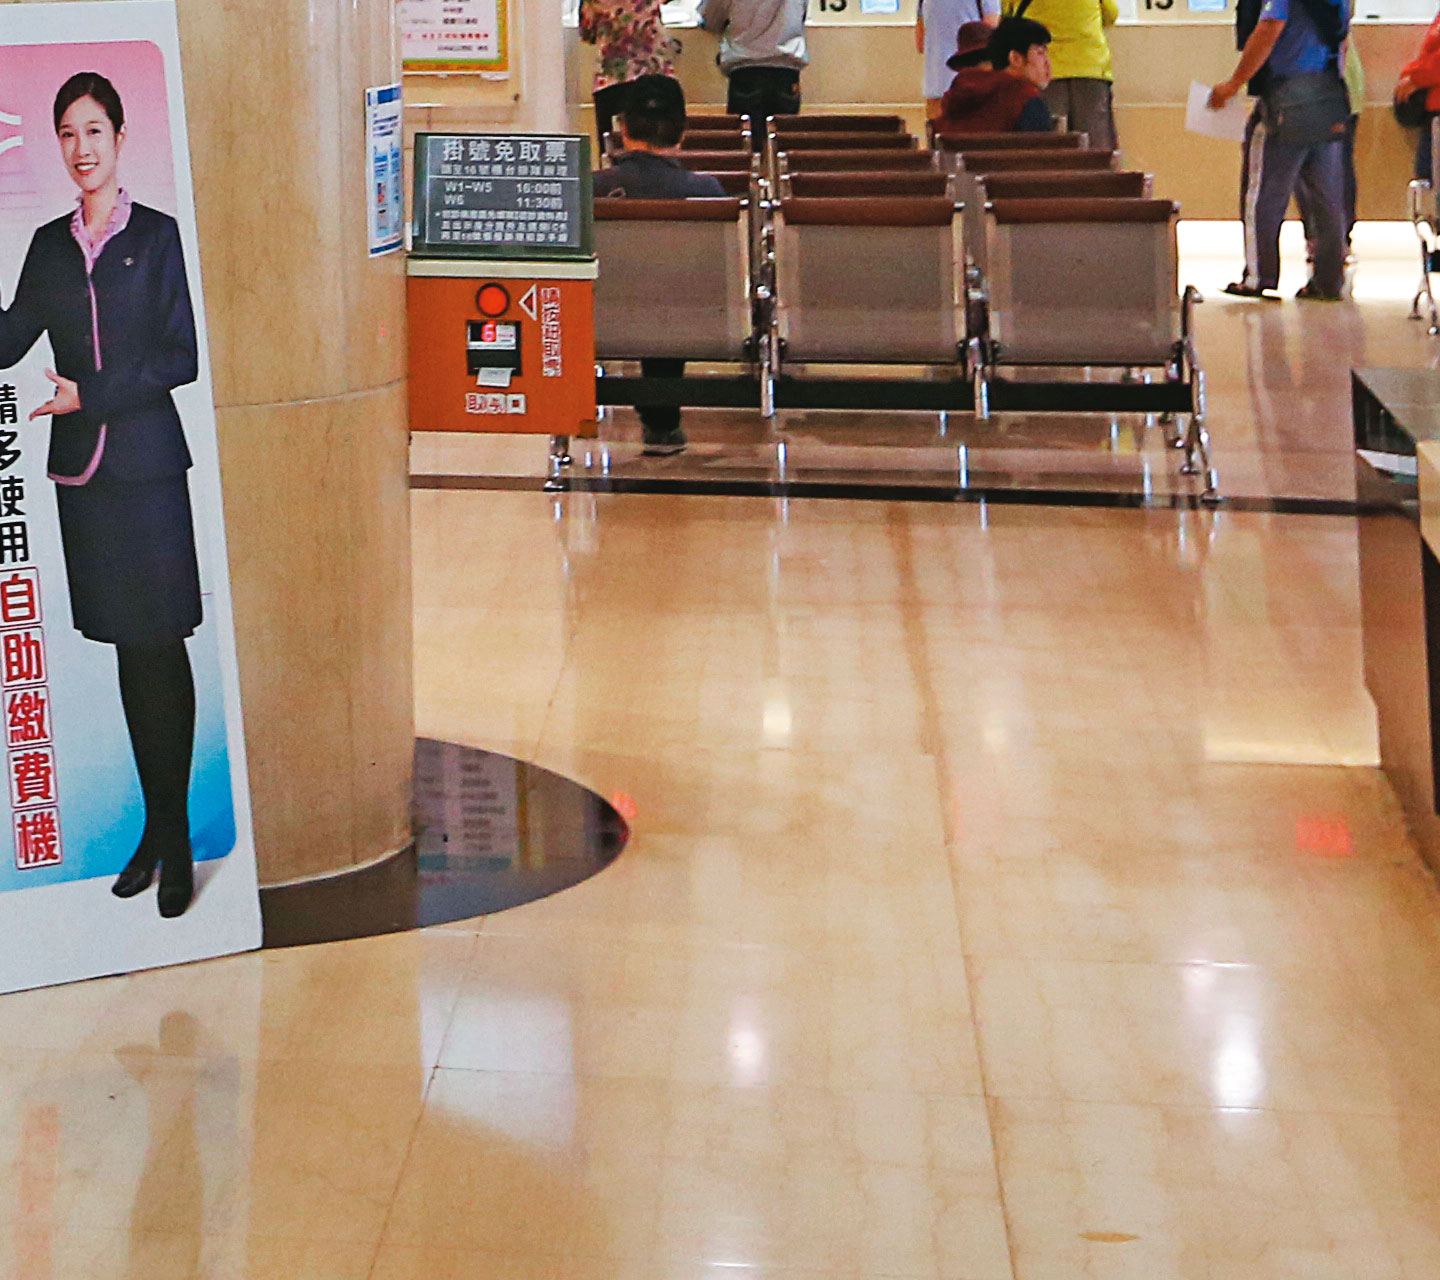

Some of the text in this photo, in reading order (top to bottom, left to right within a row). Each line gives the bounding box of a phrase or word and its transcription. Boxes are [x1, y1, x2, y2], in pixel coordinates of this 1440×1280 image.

[441, 140, 568, 162] 掛號免取票
[445, 181, 493, 193] W1-W5
[443, 194, 465, 206] W6
[482, 321, 497, 342] 6
